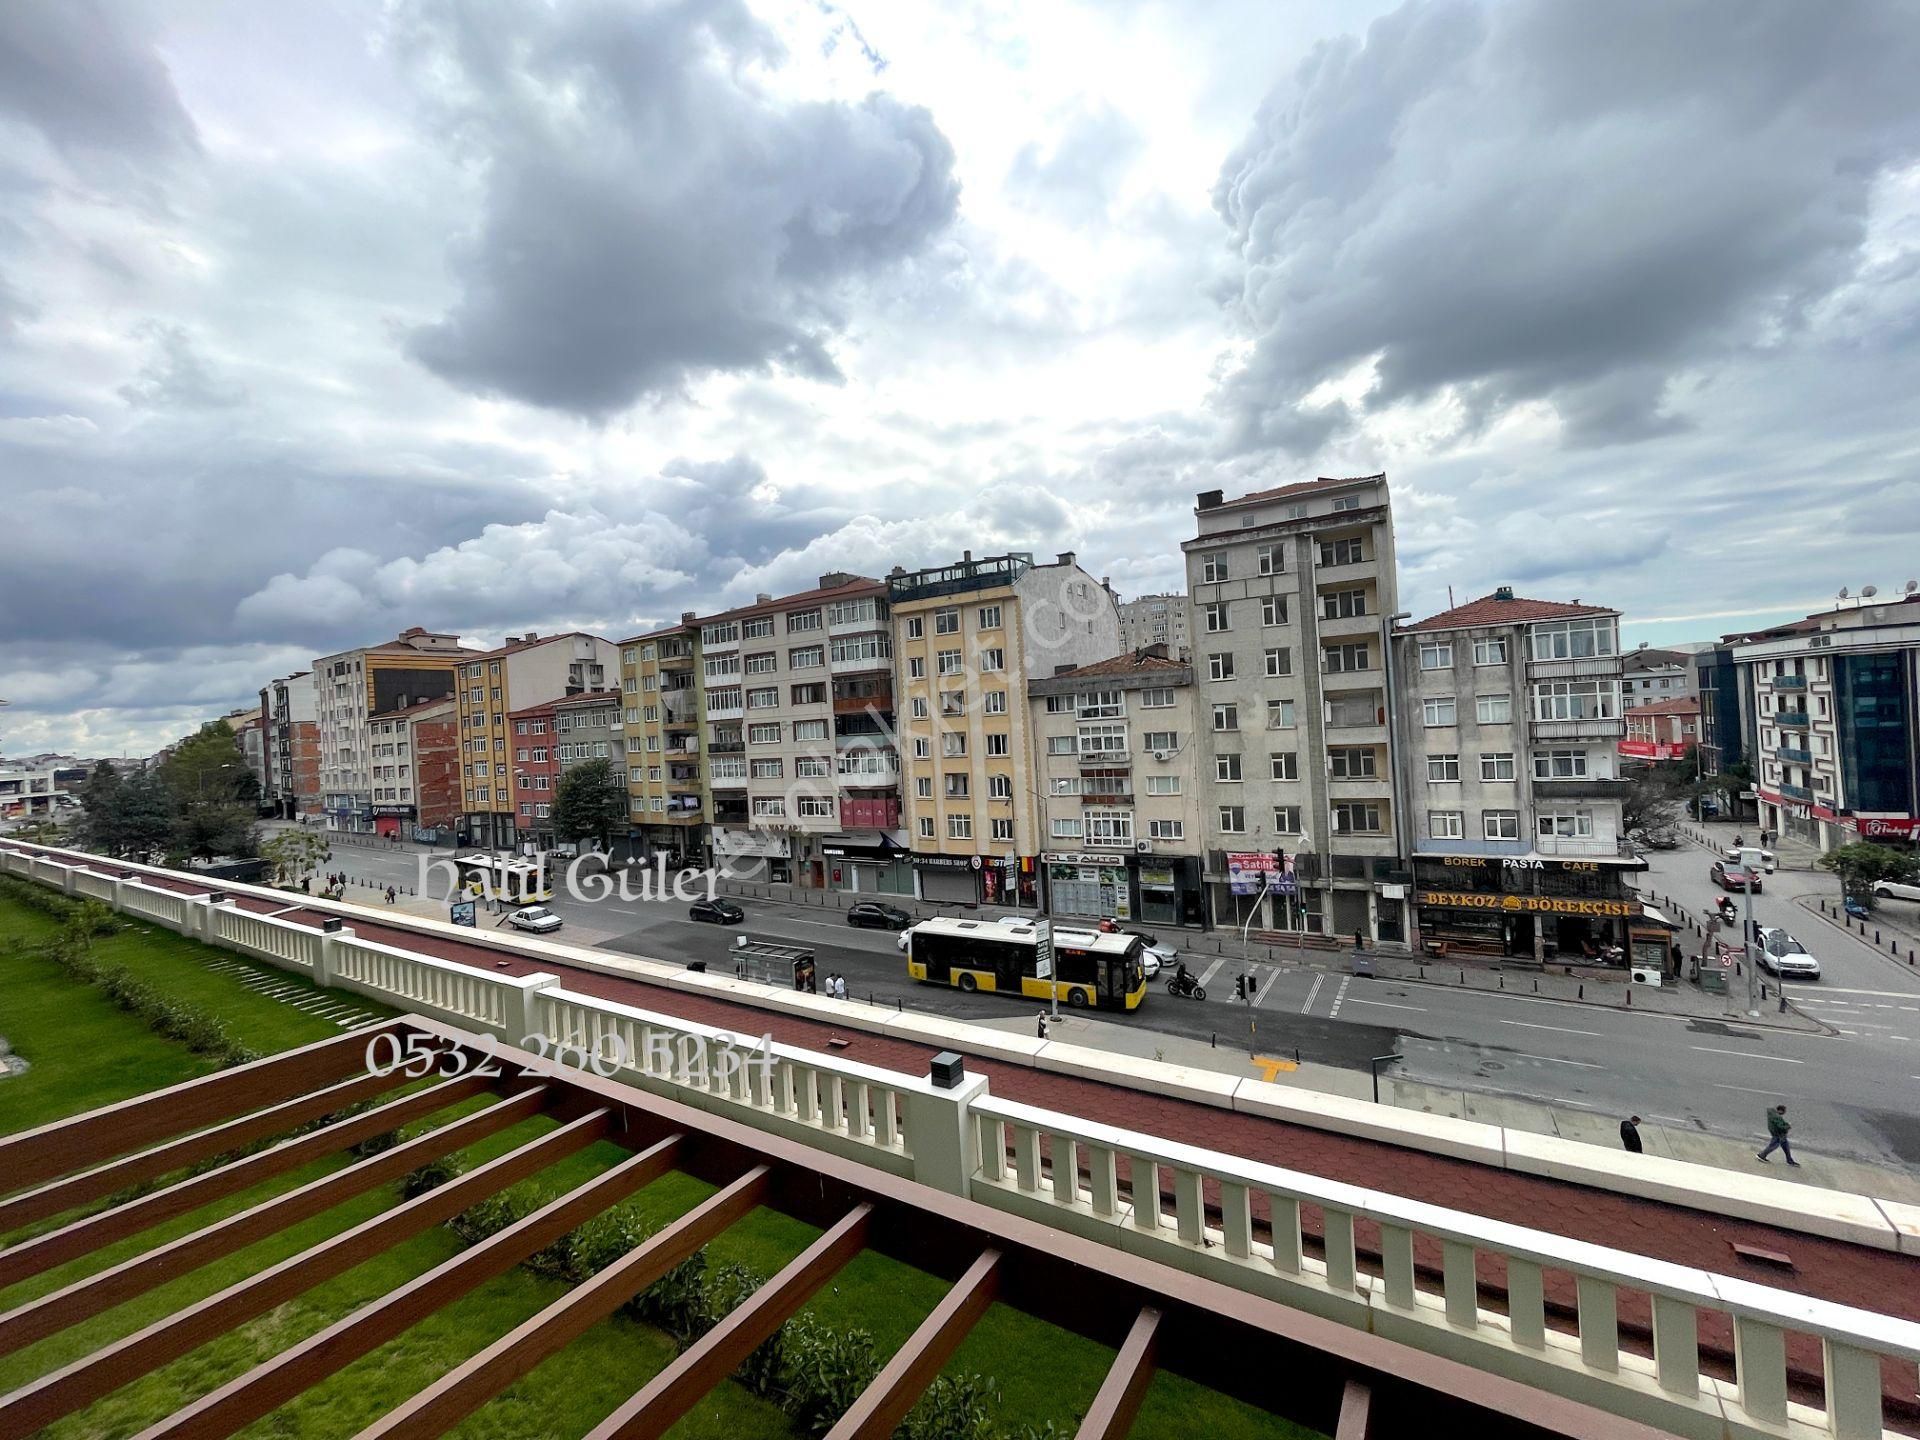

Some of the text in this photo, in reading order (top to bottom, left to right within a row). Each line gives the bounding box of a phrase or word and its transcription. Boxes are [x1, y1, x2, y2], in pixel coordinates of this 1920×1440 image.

[1080, 855, 1120, 864] AUTO
[1502, 859, 1545, 870] PASTA
[1562, 861, 1599, 872] CAFE
[1427, 892, 1630, 917] BEYKOZ BÖREKÇİSİ
